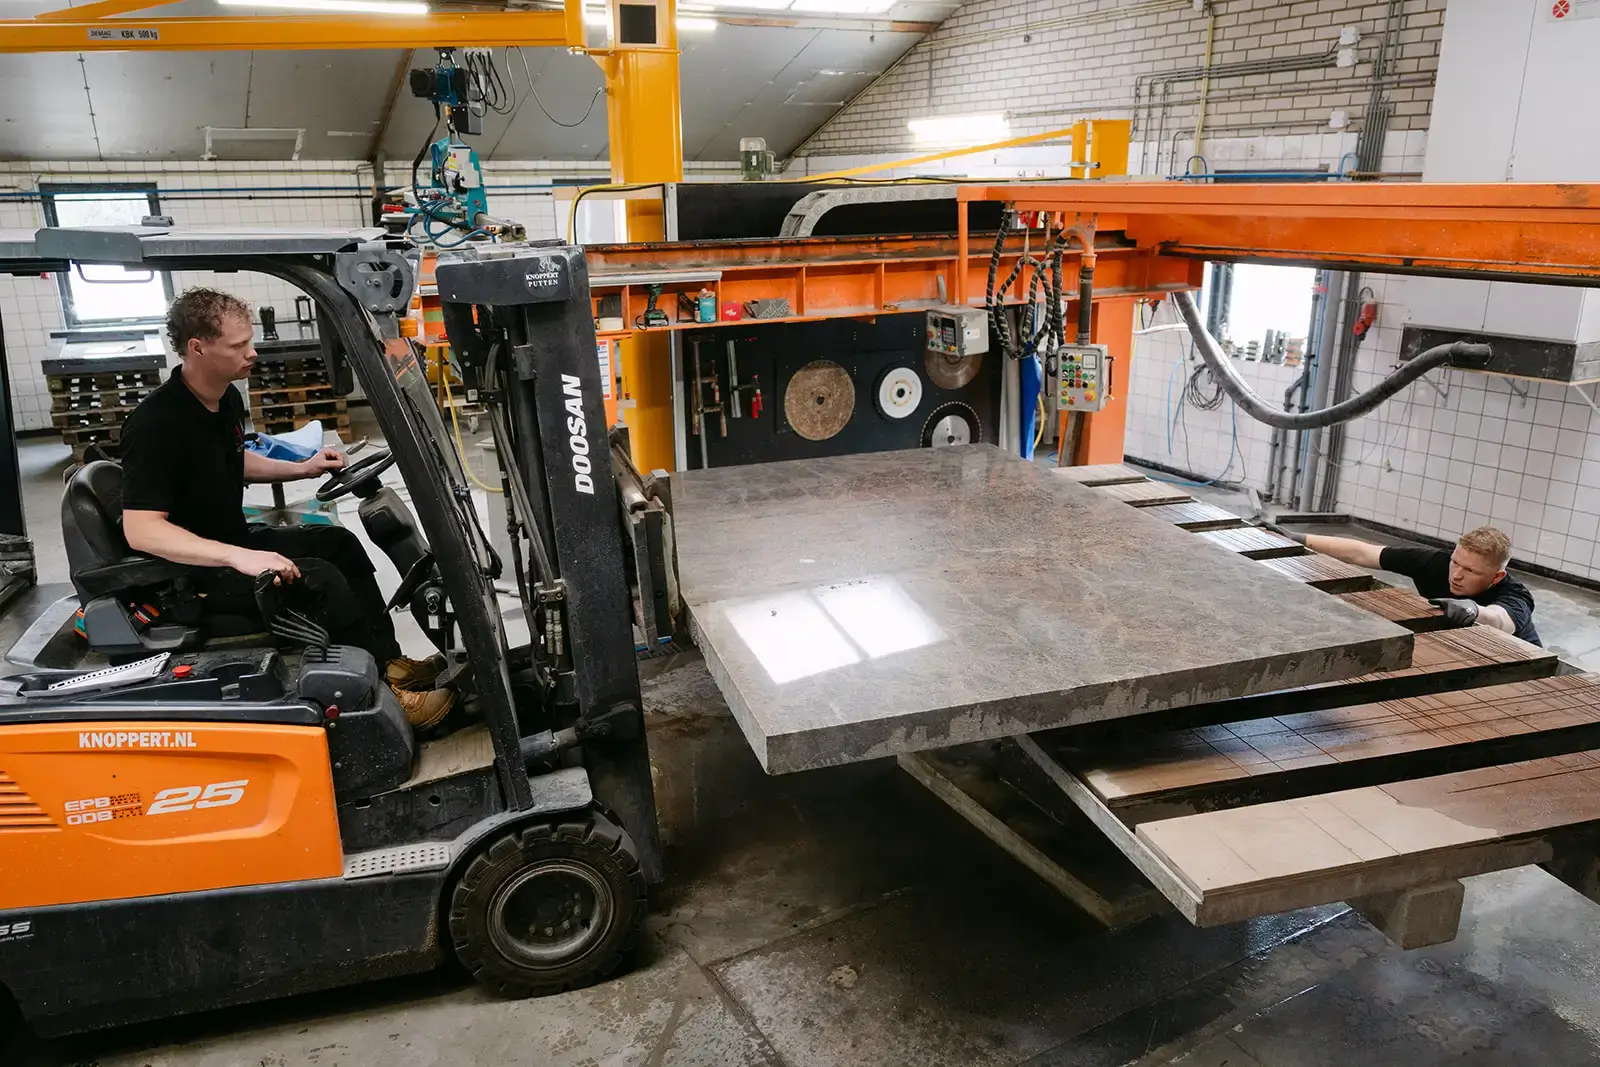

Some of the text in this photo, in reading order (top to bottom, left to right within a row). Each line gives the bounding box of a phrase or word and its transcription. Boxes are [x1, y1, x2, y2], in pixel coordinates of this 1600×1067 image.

[121, 30, 135, 39] KBK
[138, 30, 149, 39] 500
[150, 30, 158, 41] kg
[525, 272, 559, 281] KNOPPERT
[528, 279, 559, 288] PUTTEN
[561, 373, 595, 495] DOOSAN
[79, 731, 197, 749] KNOPPERT.NL
[64, 797, 111, 812] EPB
[146, 779, 249, 816] 25
[66, 811, 112, 826] ODB
